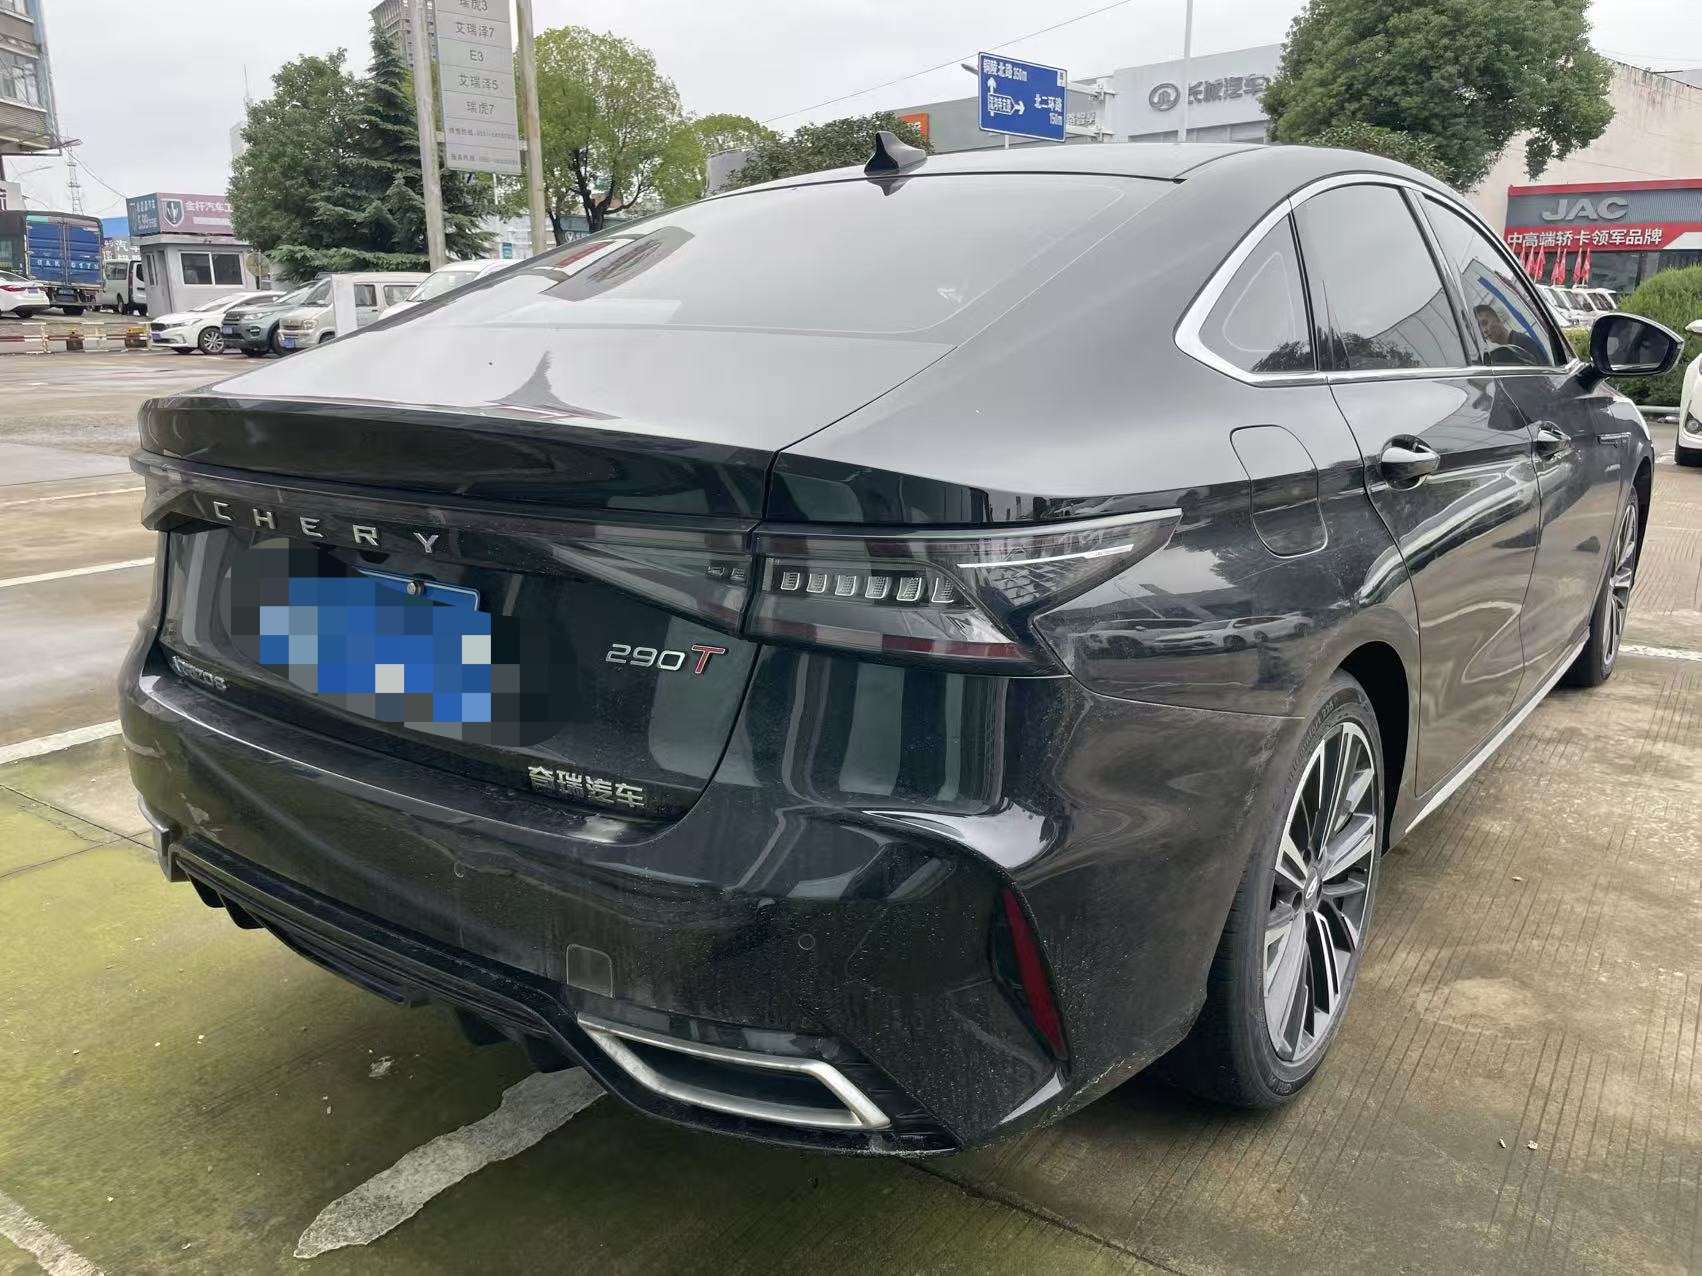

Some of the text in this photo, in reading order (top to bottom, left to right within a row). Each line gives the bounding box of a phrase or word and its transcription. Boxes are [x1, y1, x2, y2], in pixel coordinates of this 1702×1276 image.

[455, 21, 495, 38] 艾瑞泽7
[470, 50, 484, 62] E3
[458, 74, 499, 90] 艾瑞泽5
[466, 100, 495, 115] 瑞虎7
[1034, 93, 1063, 112] 北二环路
[1541, 196, 1629, 221] JAC
[1507, 228, 1663, 247] 中高端轿卡领军品牌
[213, 500, 440, 554] CHERY
[605, 643, 726, 674] 290T
[527, 765, 645, 808] 奇瑞汽车
